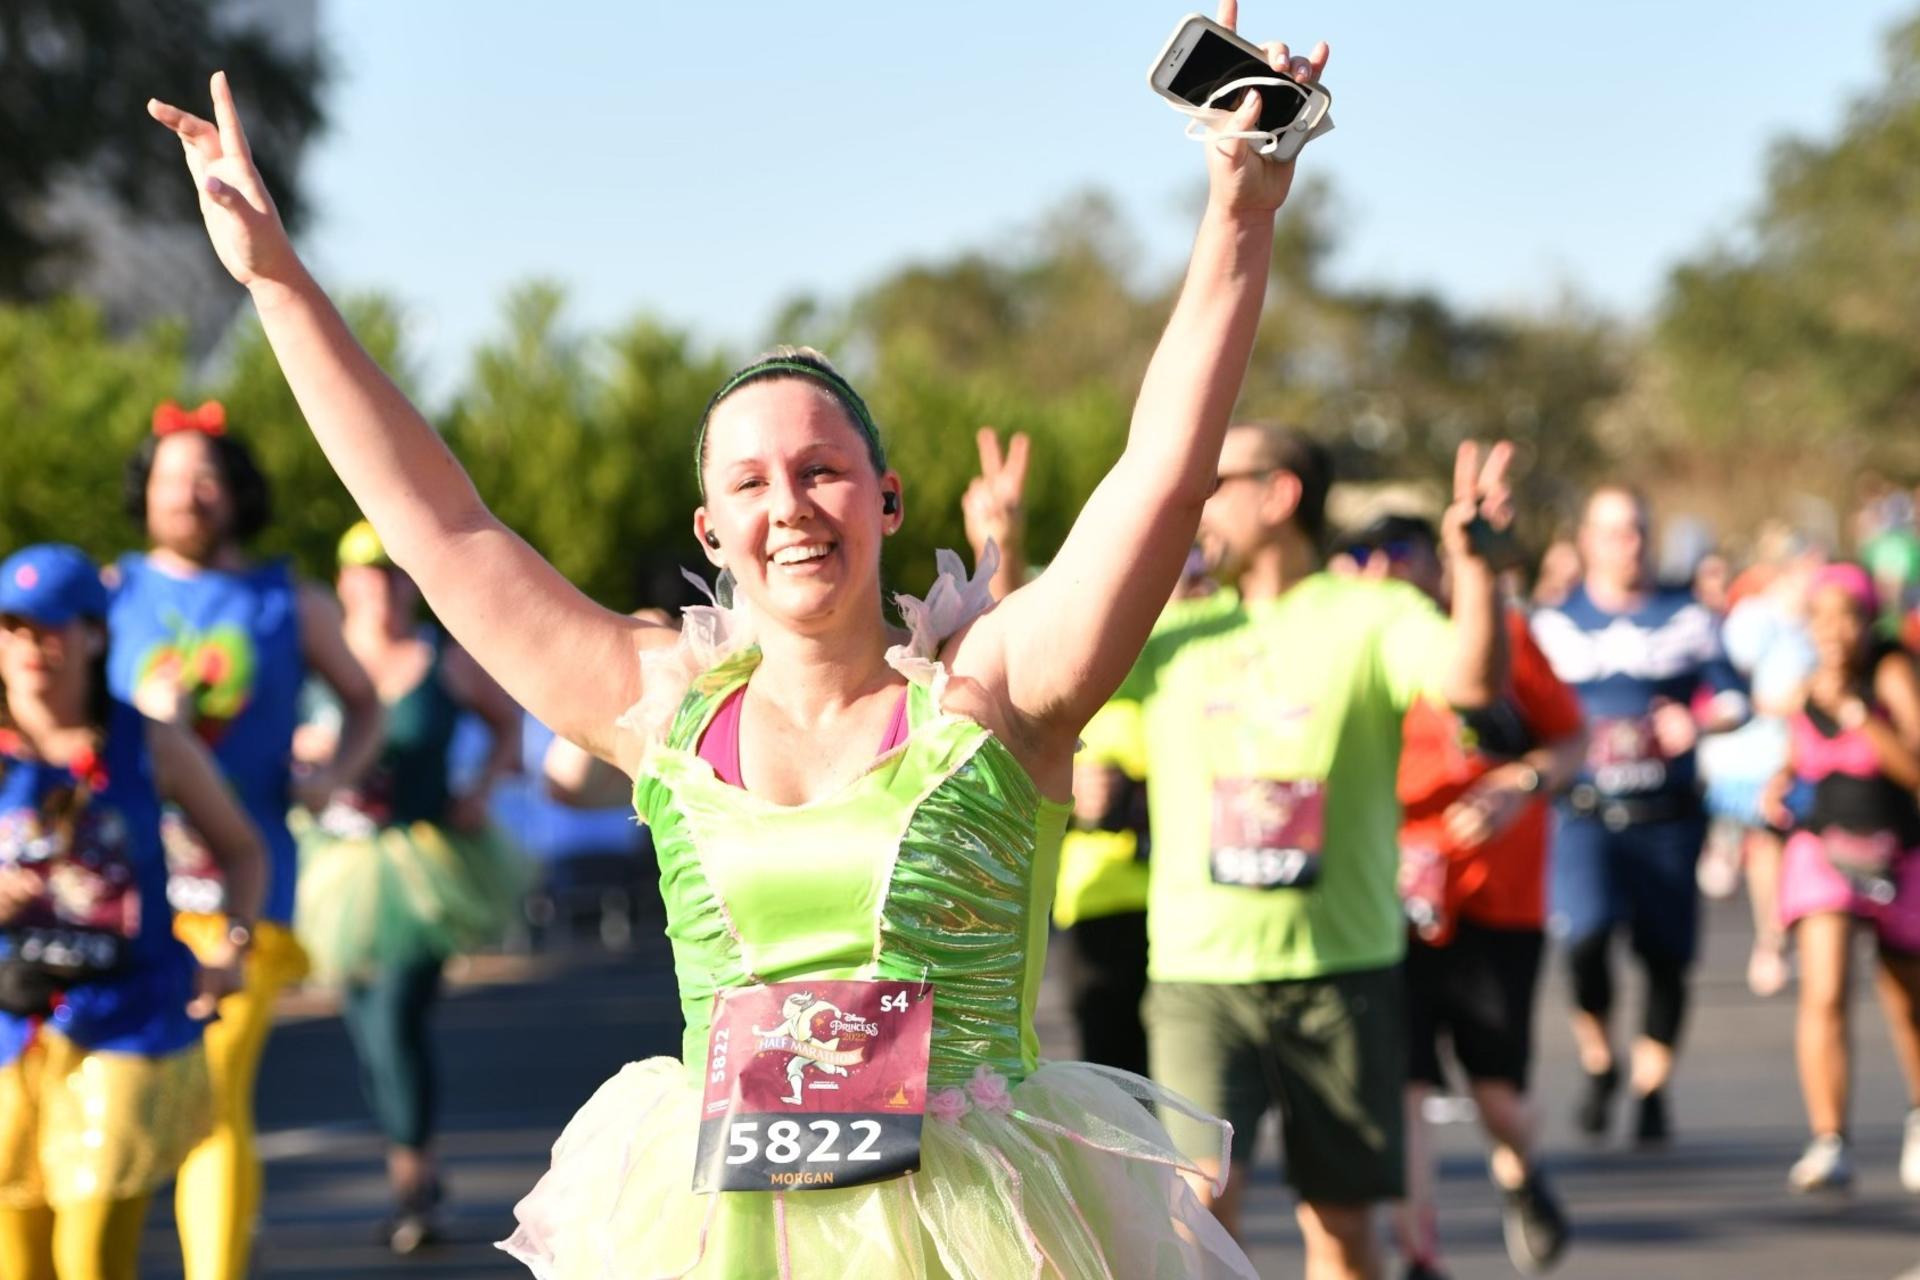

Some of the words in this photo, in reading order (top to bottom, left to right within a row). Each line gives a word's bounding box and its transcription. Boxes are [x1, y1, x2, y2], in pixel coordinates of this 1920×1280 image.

[713, 1028, 729, 1082] 5822
[760, 1037, 787, 1050] HALF
[791, 1041, 855, 1064] MARATHON
[726, 1120, 881, 1164] 5822
[771, 1172, 833, 1184] MORGAN
